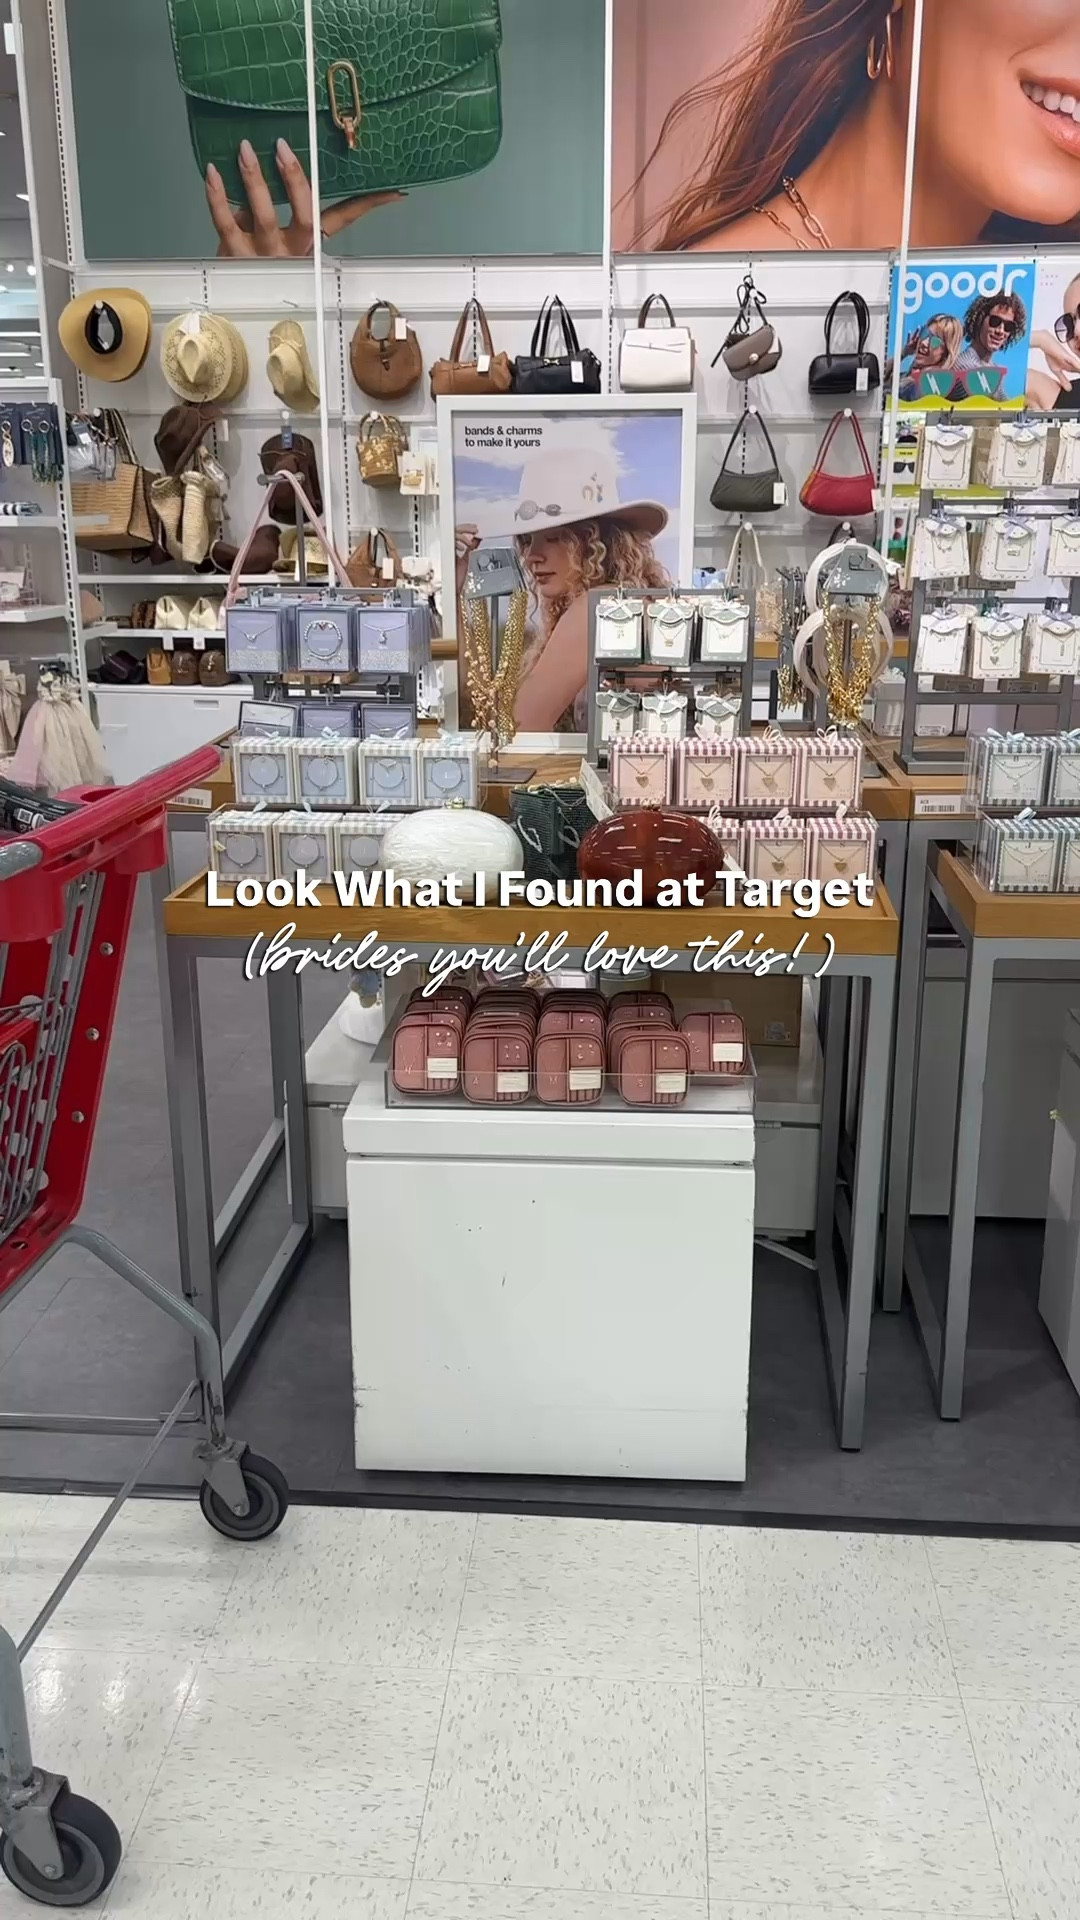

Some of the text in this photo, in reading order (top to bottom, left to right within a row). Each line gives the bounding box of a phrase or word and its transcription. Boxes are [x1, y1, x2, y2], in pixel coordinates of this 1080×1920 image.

[904, 264, 1028, 314] goodr
[464, 425, 543, 436] bands & charms
[464, 437, 541, 449] to make it yours
